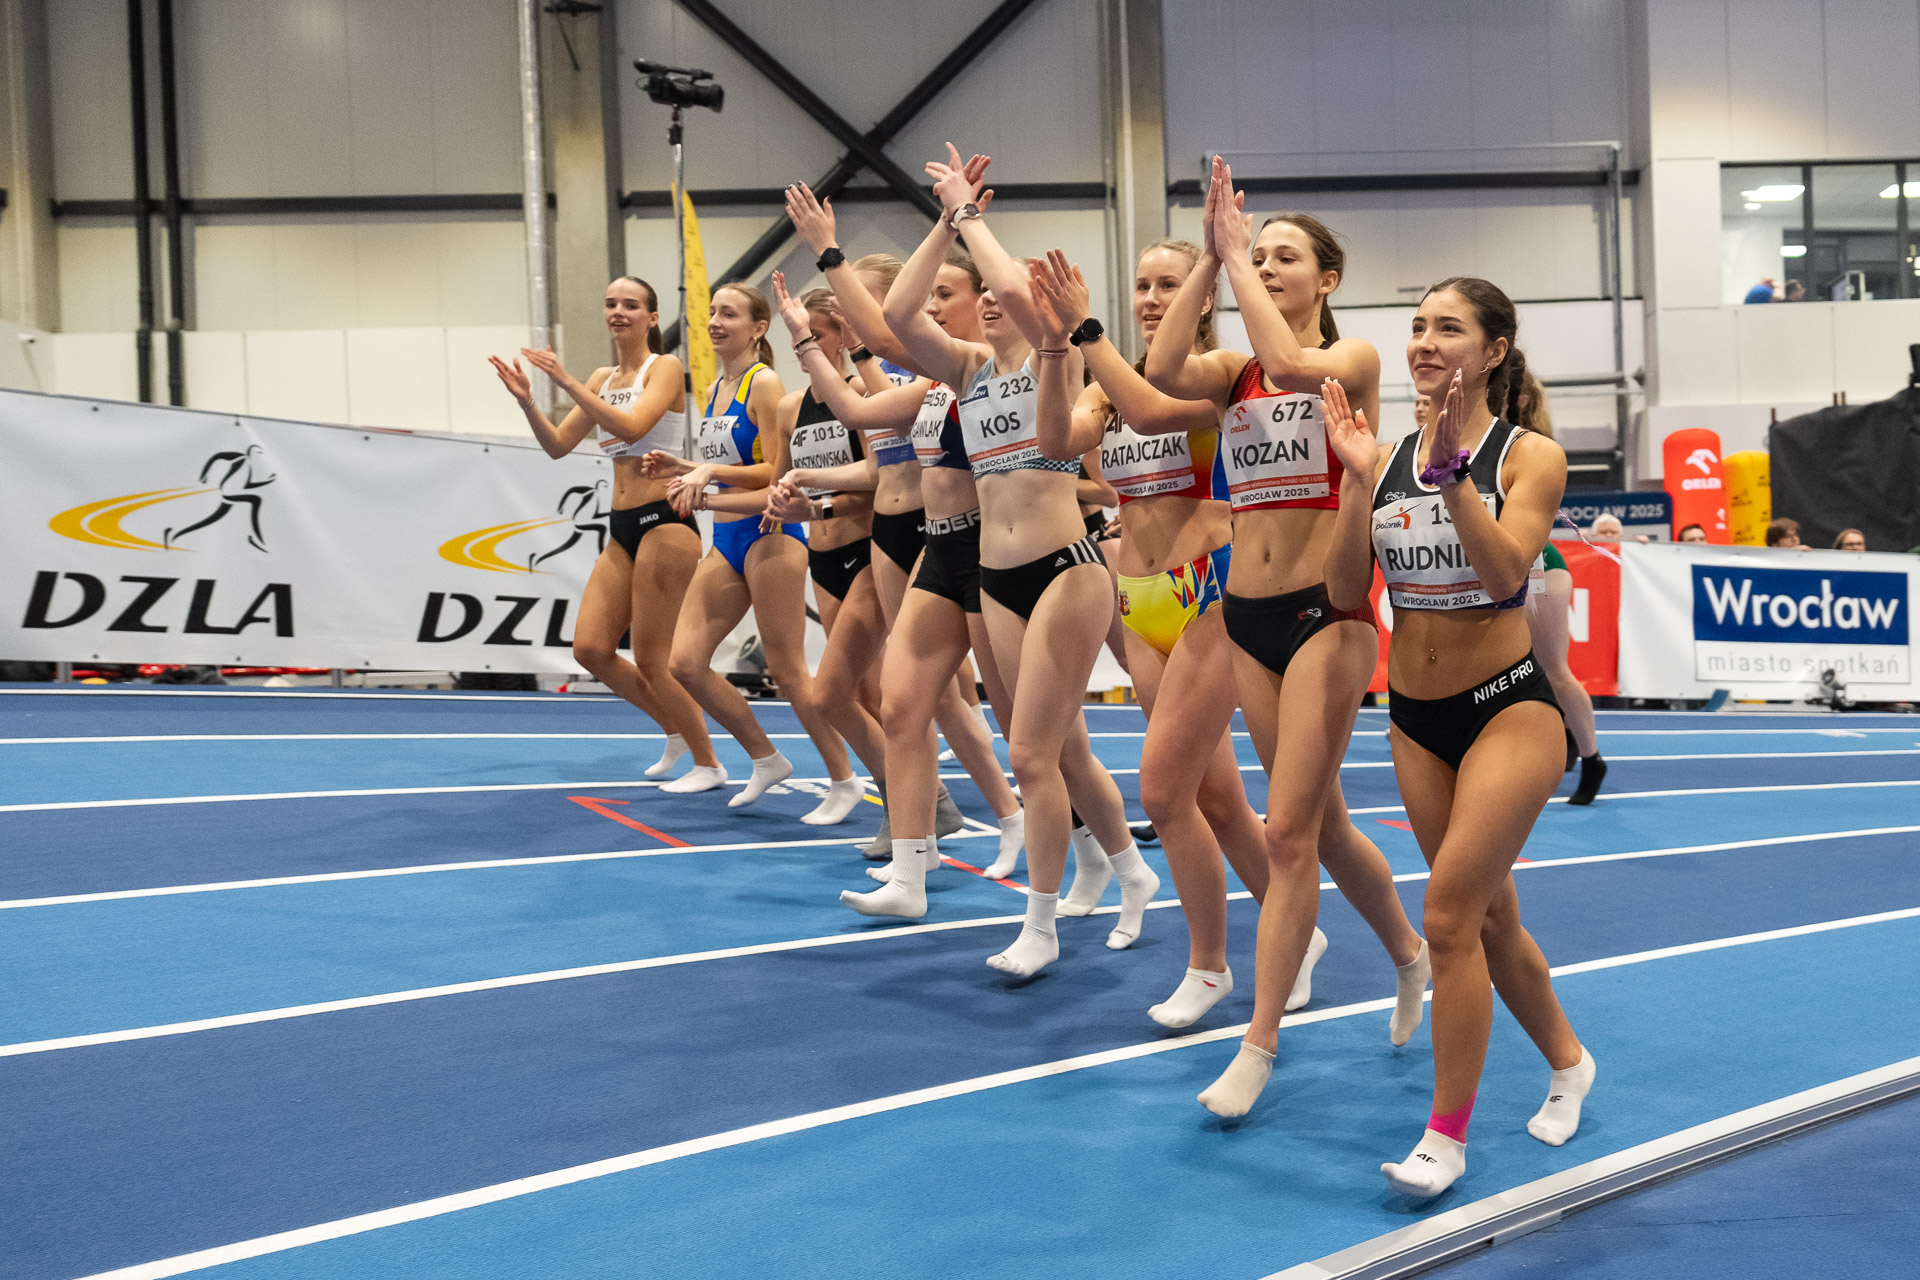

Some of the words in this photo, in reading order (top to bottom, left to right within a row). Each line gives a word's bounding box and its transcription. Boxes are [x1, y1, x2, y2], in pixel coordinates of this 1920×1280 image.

[1000, 376, 1034, 399] 232
[610, 392, 632, 405] 299
[1272, 400, 1313, 422] 672
[713, 420, 730, 433] 949
[980, 411, 1021, 438] KOS
[1230, 424, 1251, 434] ORLEN
[793, 429, 808, 447] 4F
[812, 424, 845, 442] 1013
[979, 453, 1020, 470] WROCŁAW
[1102, 435, 1185, 469] RATAJCZAK
[1232, 438, 1309, 470] KOZAN
[1157, 481, 1179, 491] 2025
[1240, 491, 1282, 503] WROCŁAW
[1284, 488, 1310, 497] 2025
[639, 513, 659, 524] JAKO
[1556, 504, 1626, 520] ROCŁAW
[1629, 504, 1665, 517] 2025
[1375, 520, 1402, 531] polanik
[21, 570, 295, 638] DZLA
[1402, 597, 1449, 607] WROCŁAW
[1452, 594, 1480, 605] 2025
[1703, 577, 1899, 630] Wrocław
[417, 592, 575, 648] DZL
[1708, 652, 1792, 672] miasto
[1804, 653, 1899, 675] spotkań
[1473, 675, 1509, 704] NIKE
[1510, 660, 1534, 684] PRO
[1416, 1153, 1437, 1163] 4F
